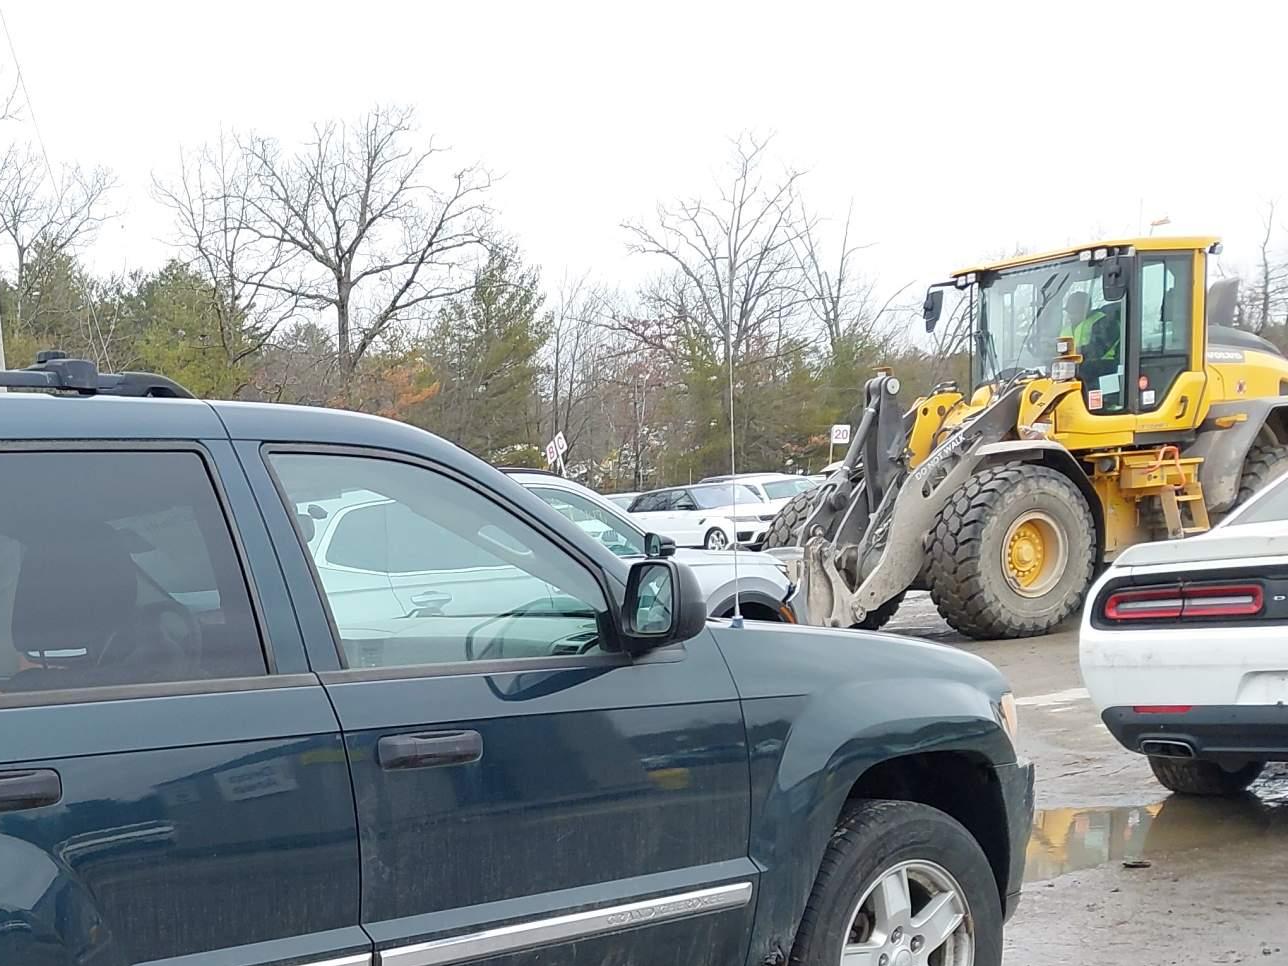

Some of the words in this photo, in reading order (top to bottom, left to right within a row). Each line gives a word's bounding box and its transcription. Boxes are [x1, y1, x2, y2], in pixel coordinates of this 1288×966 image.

[835, 428, 849, 440] 20
[557, 436, 565, 450] C
[548, 446, 555, 460] B
[915, 467, 928, 480] DO
[927, 453, 943, 469] NOT
[943, 433, 966, 454] WALK
